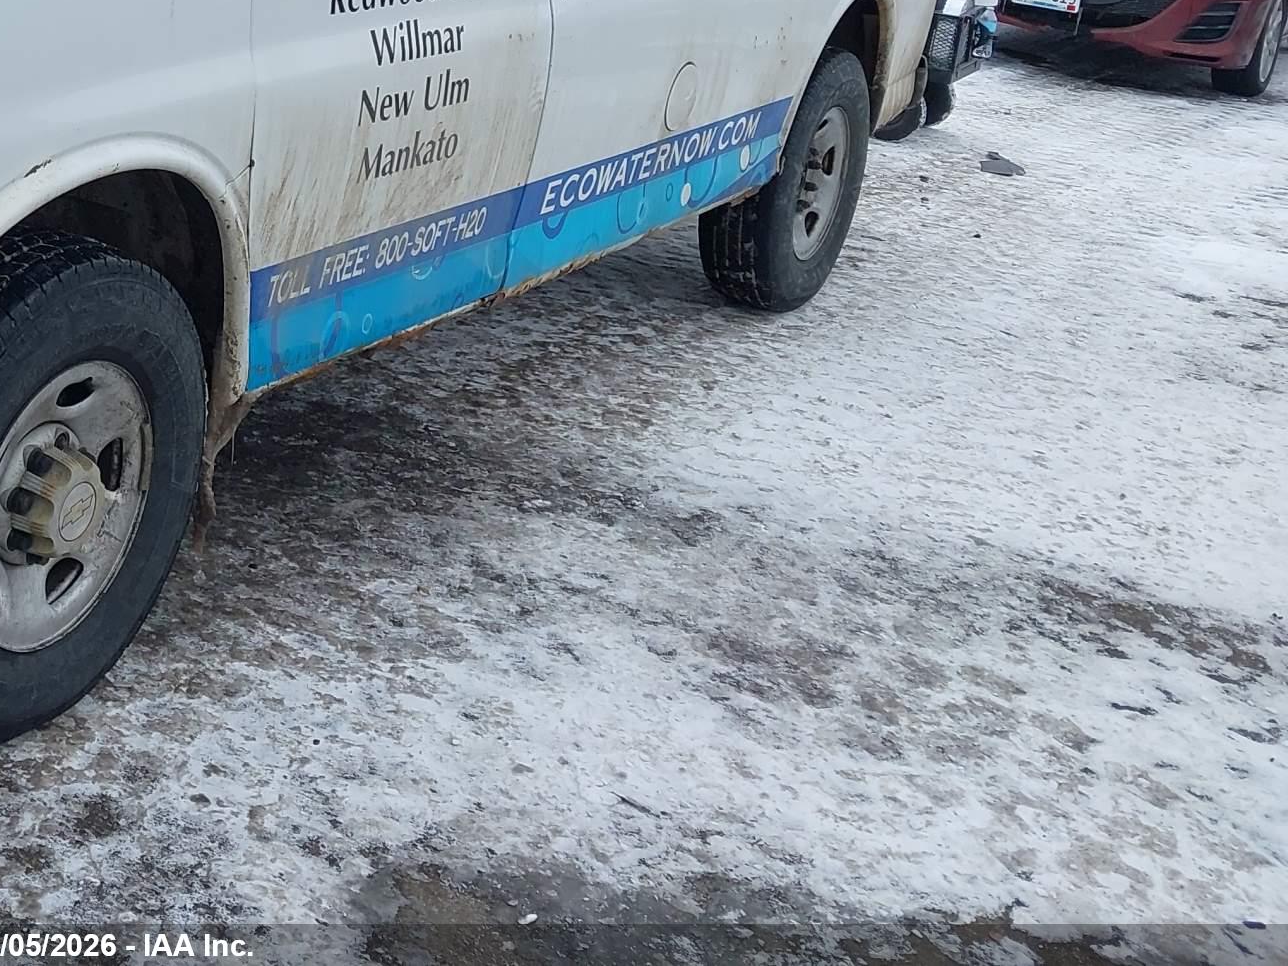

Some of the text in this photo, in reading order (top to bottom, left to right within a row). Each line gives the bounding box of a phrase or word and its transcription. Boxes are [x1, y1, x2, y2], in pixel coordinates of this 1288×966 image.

[370, 20, 465, 67] Willmar
[357, 69, 470, 127] New Ulm
[356, 128, 459, 183] Mankato
[539, 110, 762, 217] ECOWATERNOW.COM
[266, 264, 312, 308] TOLL
[318, 245, 371, 290] FREE:
